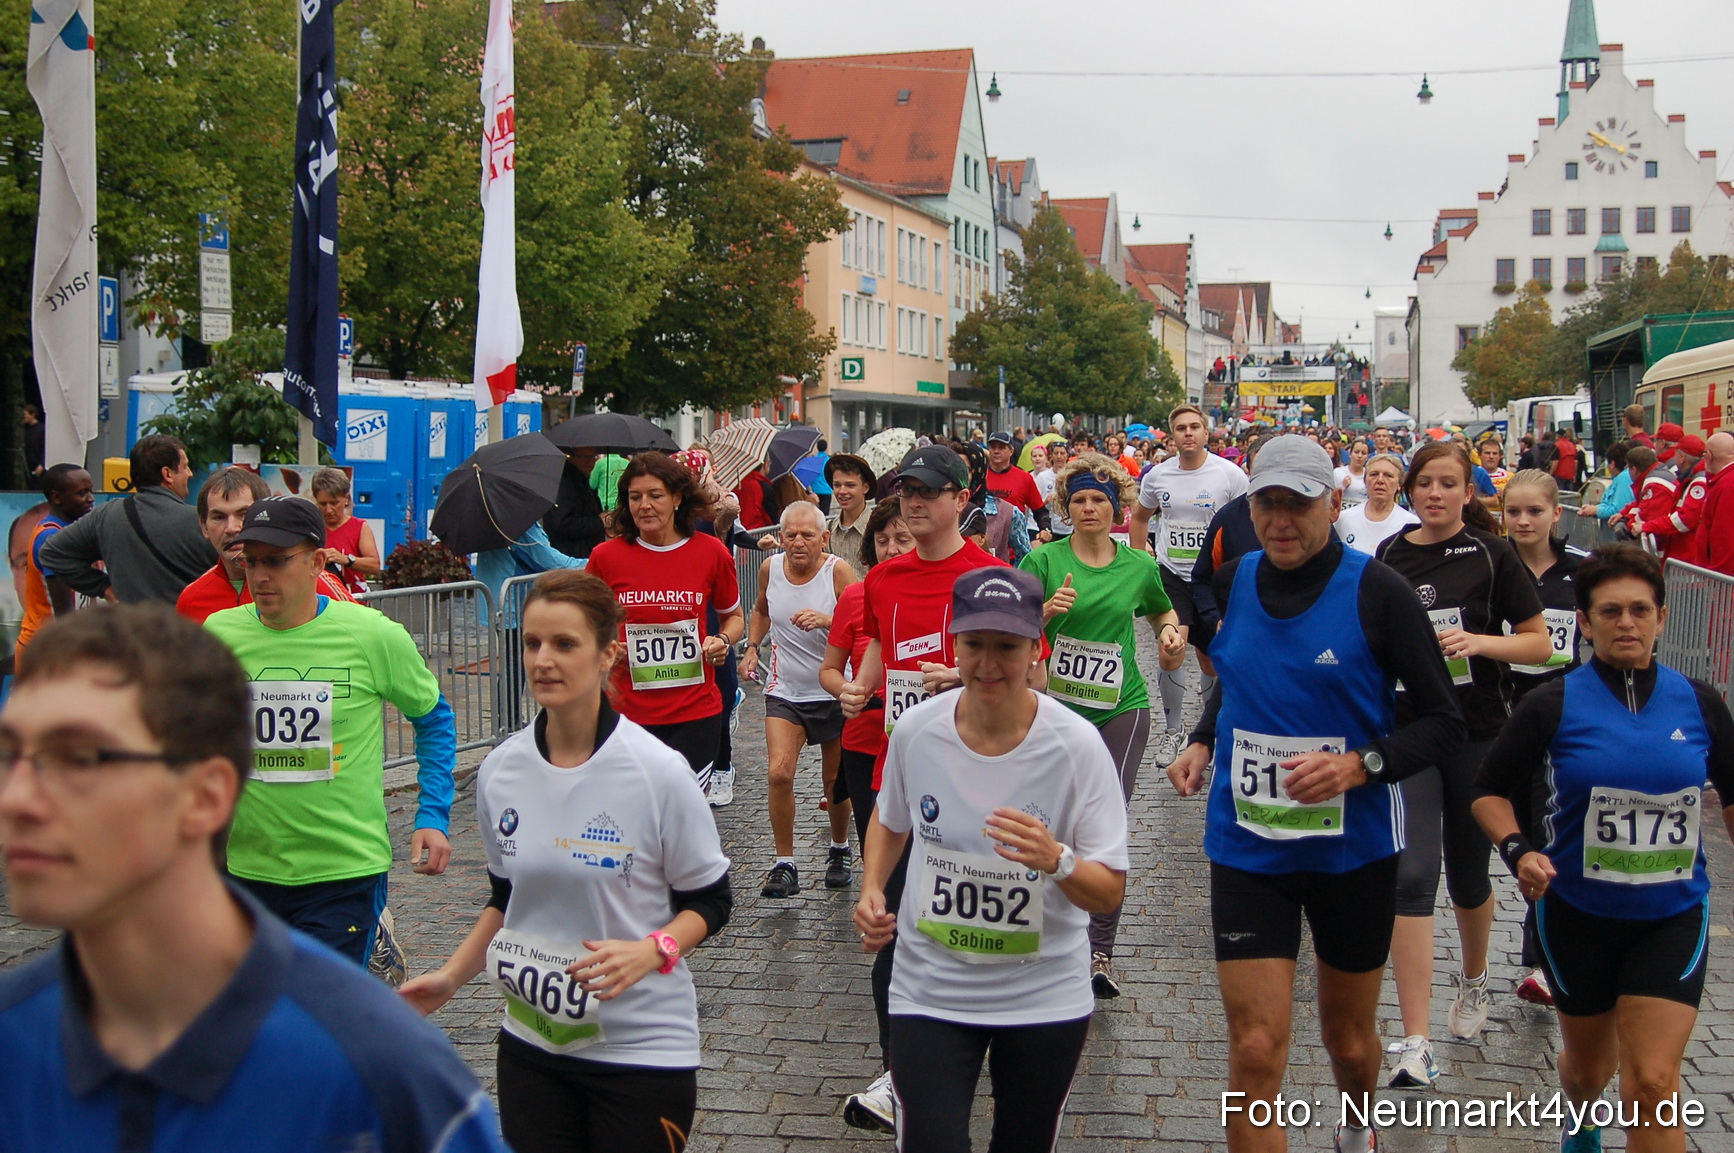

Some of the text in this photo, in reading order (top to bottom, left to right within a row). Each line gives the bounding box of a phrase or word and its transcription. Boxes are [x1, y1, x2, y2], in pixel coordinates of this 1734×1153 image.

[103, 286, 115, 335] P
[340, 322, 350, 351] P
[575, 348, 584, 370] P
[844, 360, 861, 378] D
[1270, 385, 1302, 393] START
[1170, 531, 1205, 548] 5156
[1454, 546, 1477, 554] DEKRA
[618, 590, 693, 604] NEUMARKT
[635, 636, 697, 664] 5075
[909, 641, 929, 653] DEHN
[1056, 639, 1114, 656] PARTL Neumarkt
[654, 668, 680, 679] Anita
[1056, 651, 1118, 684] 5072
[887, 678, 907, 687] PARTL
[1064, 683, 1100, 699] Brigitte
[261, 692, 312, 701] Neumarkt
[1629, 797, 1679, 810] Neumarkt
[1250, 805, 1318, 826] ERNST
[1597, 809, 1687, 845] 5173
[926, 855, 1020, 881] PARTL Neumarkt
[1598, 850, 1678, 869] KAROLA
[931, 874, 1031, 926] 5052
[491, 938, 527, 957] PARTL
[949, 929, 1004, 950] Sabine
[497, 959, 590, 1020] 5069
[536, 1013, 552, 1038] Ute
